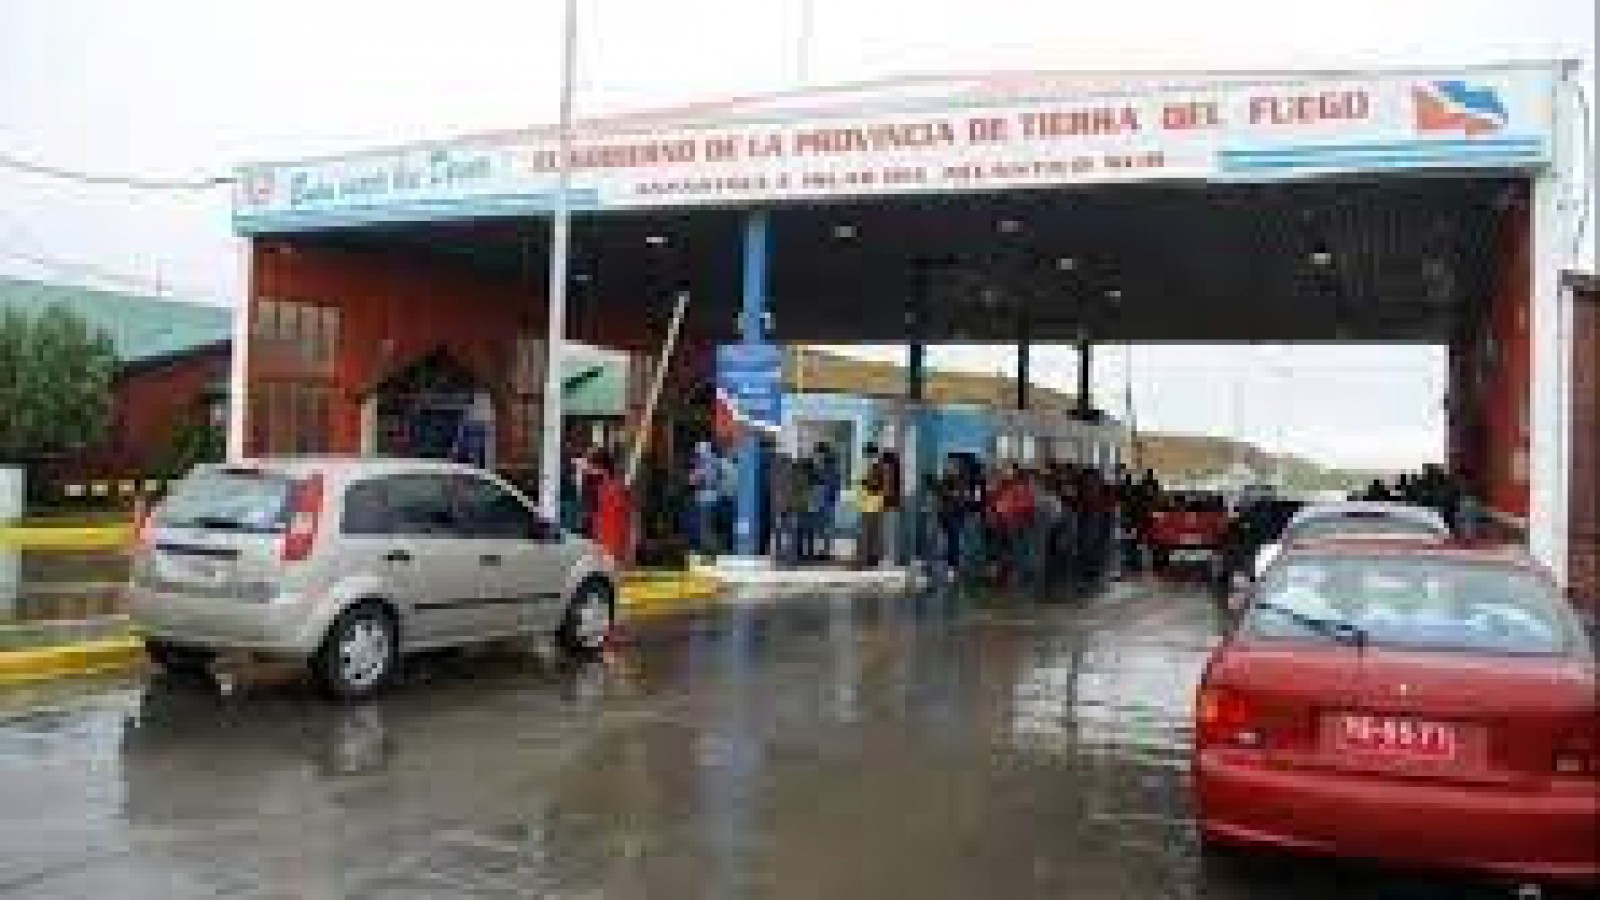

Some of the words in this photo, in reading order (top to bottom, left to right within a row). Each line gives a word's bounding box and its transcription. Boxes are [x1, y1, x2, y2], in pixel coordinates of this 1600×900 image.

[569, 139, 696, 169] GOBIERNO
[706, 138, 735, 162] DE
[748, 133, 783, 157] LA
[795, 123, 955, 157] PROVINCIA
[969, 117, 1008, 142] DE
[1019, 105, 1139, 141] TIERRA
[1163, 101, 1222, 131] DEL
[1249, 91, 1370, 125] FUEGO
